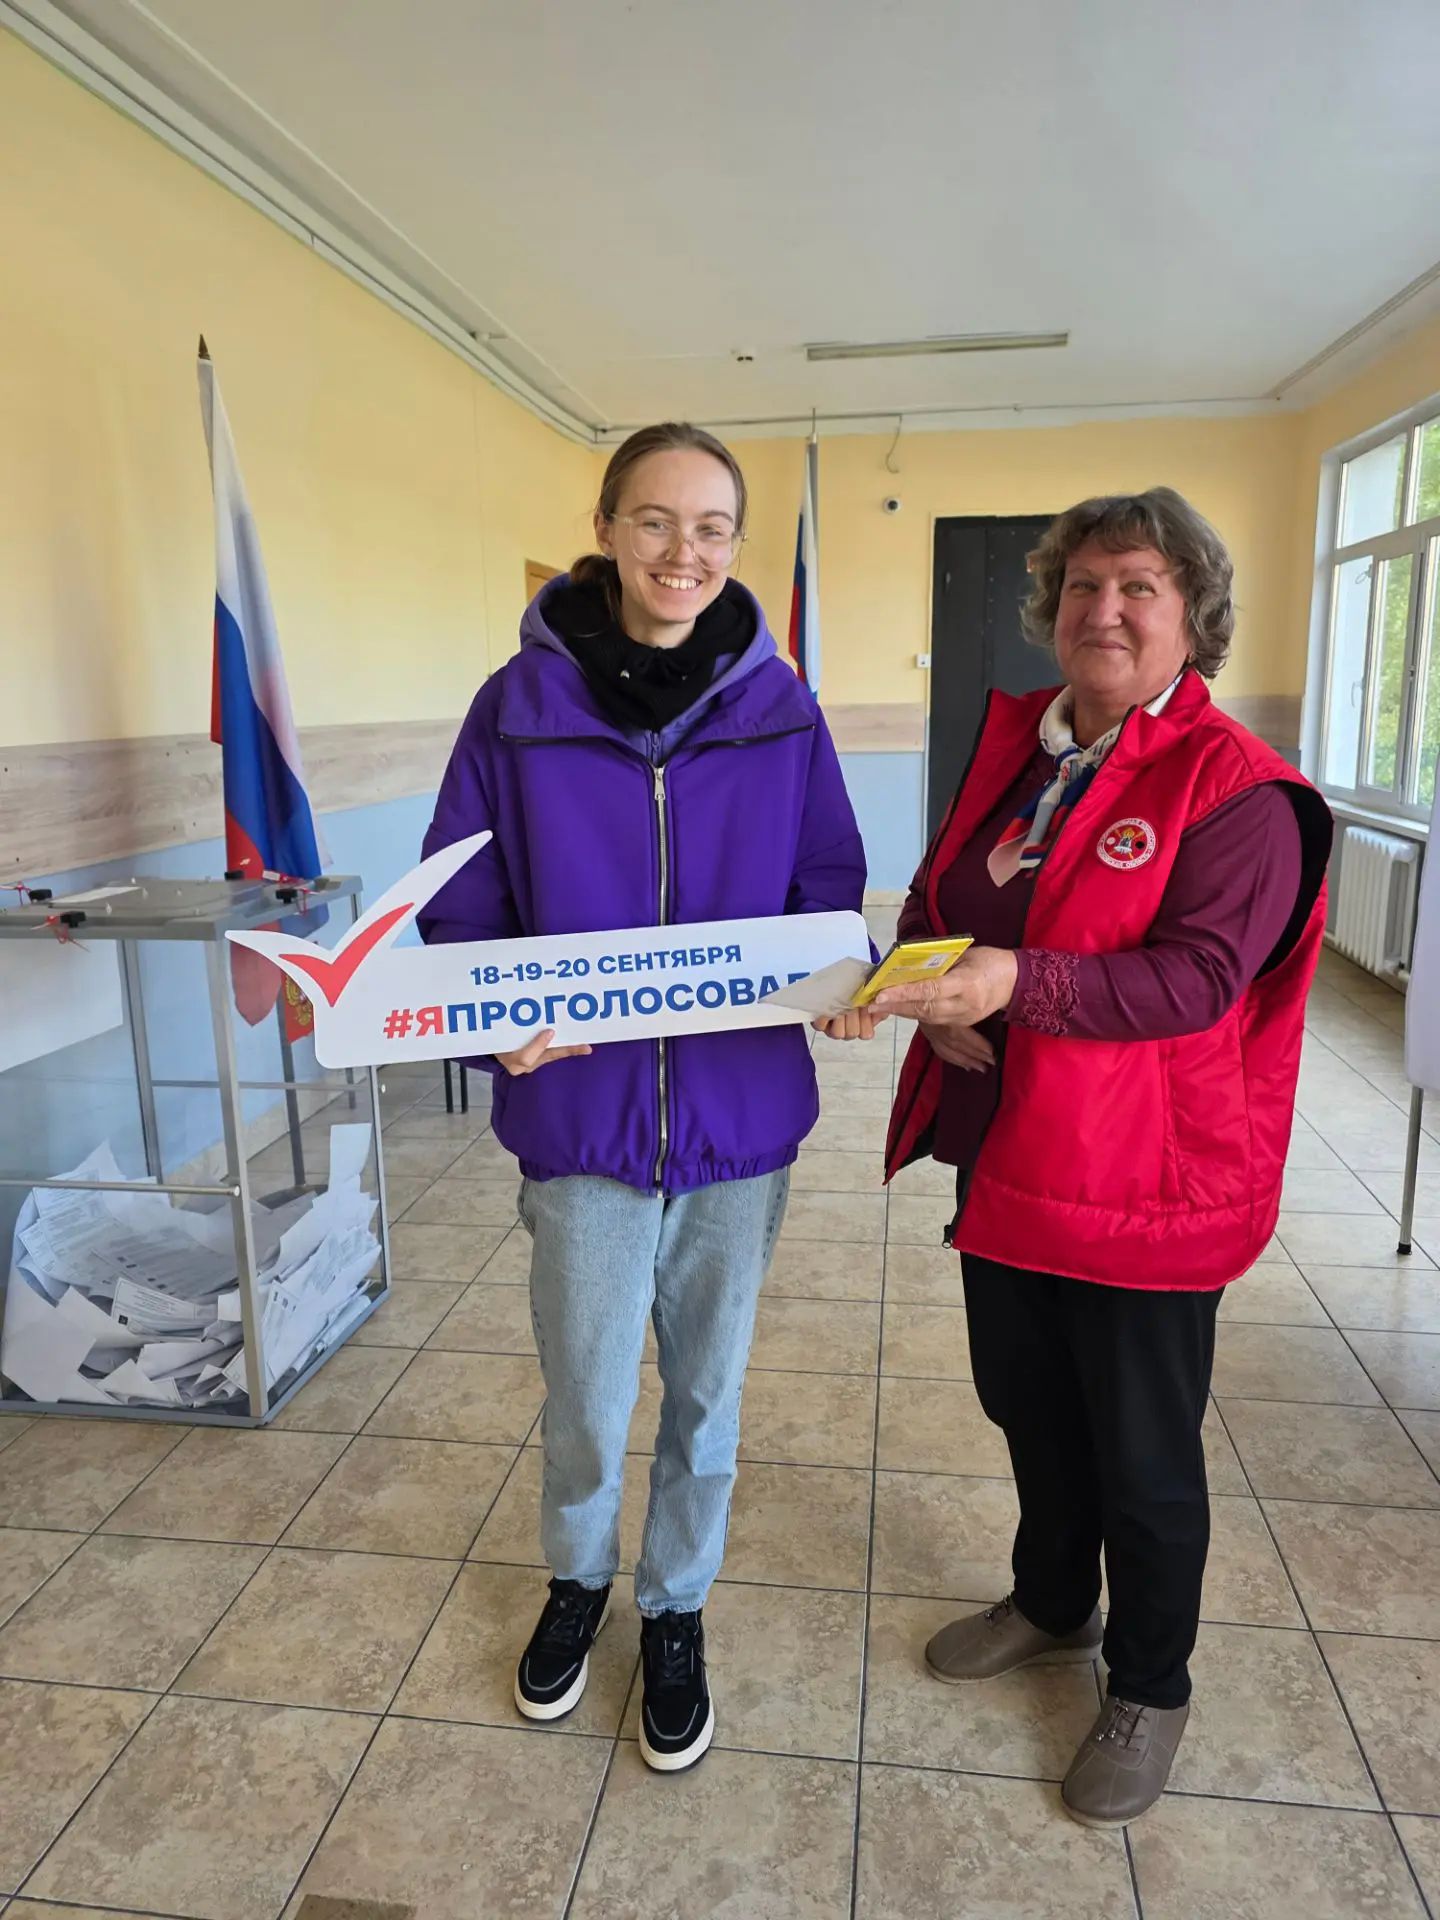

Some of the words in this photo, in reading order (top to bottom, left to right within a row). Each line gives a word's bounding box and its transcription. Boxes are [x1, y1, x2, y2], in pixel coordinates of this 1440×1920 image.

[470, 959, 591, 985] 18-19-20
[597, 945, 742, 976] СЕНТЯБРЯ
[383, 972, 811, 1040] #ЯПРОГОЛОСОВА
